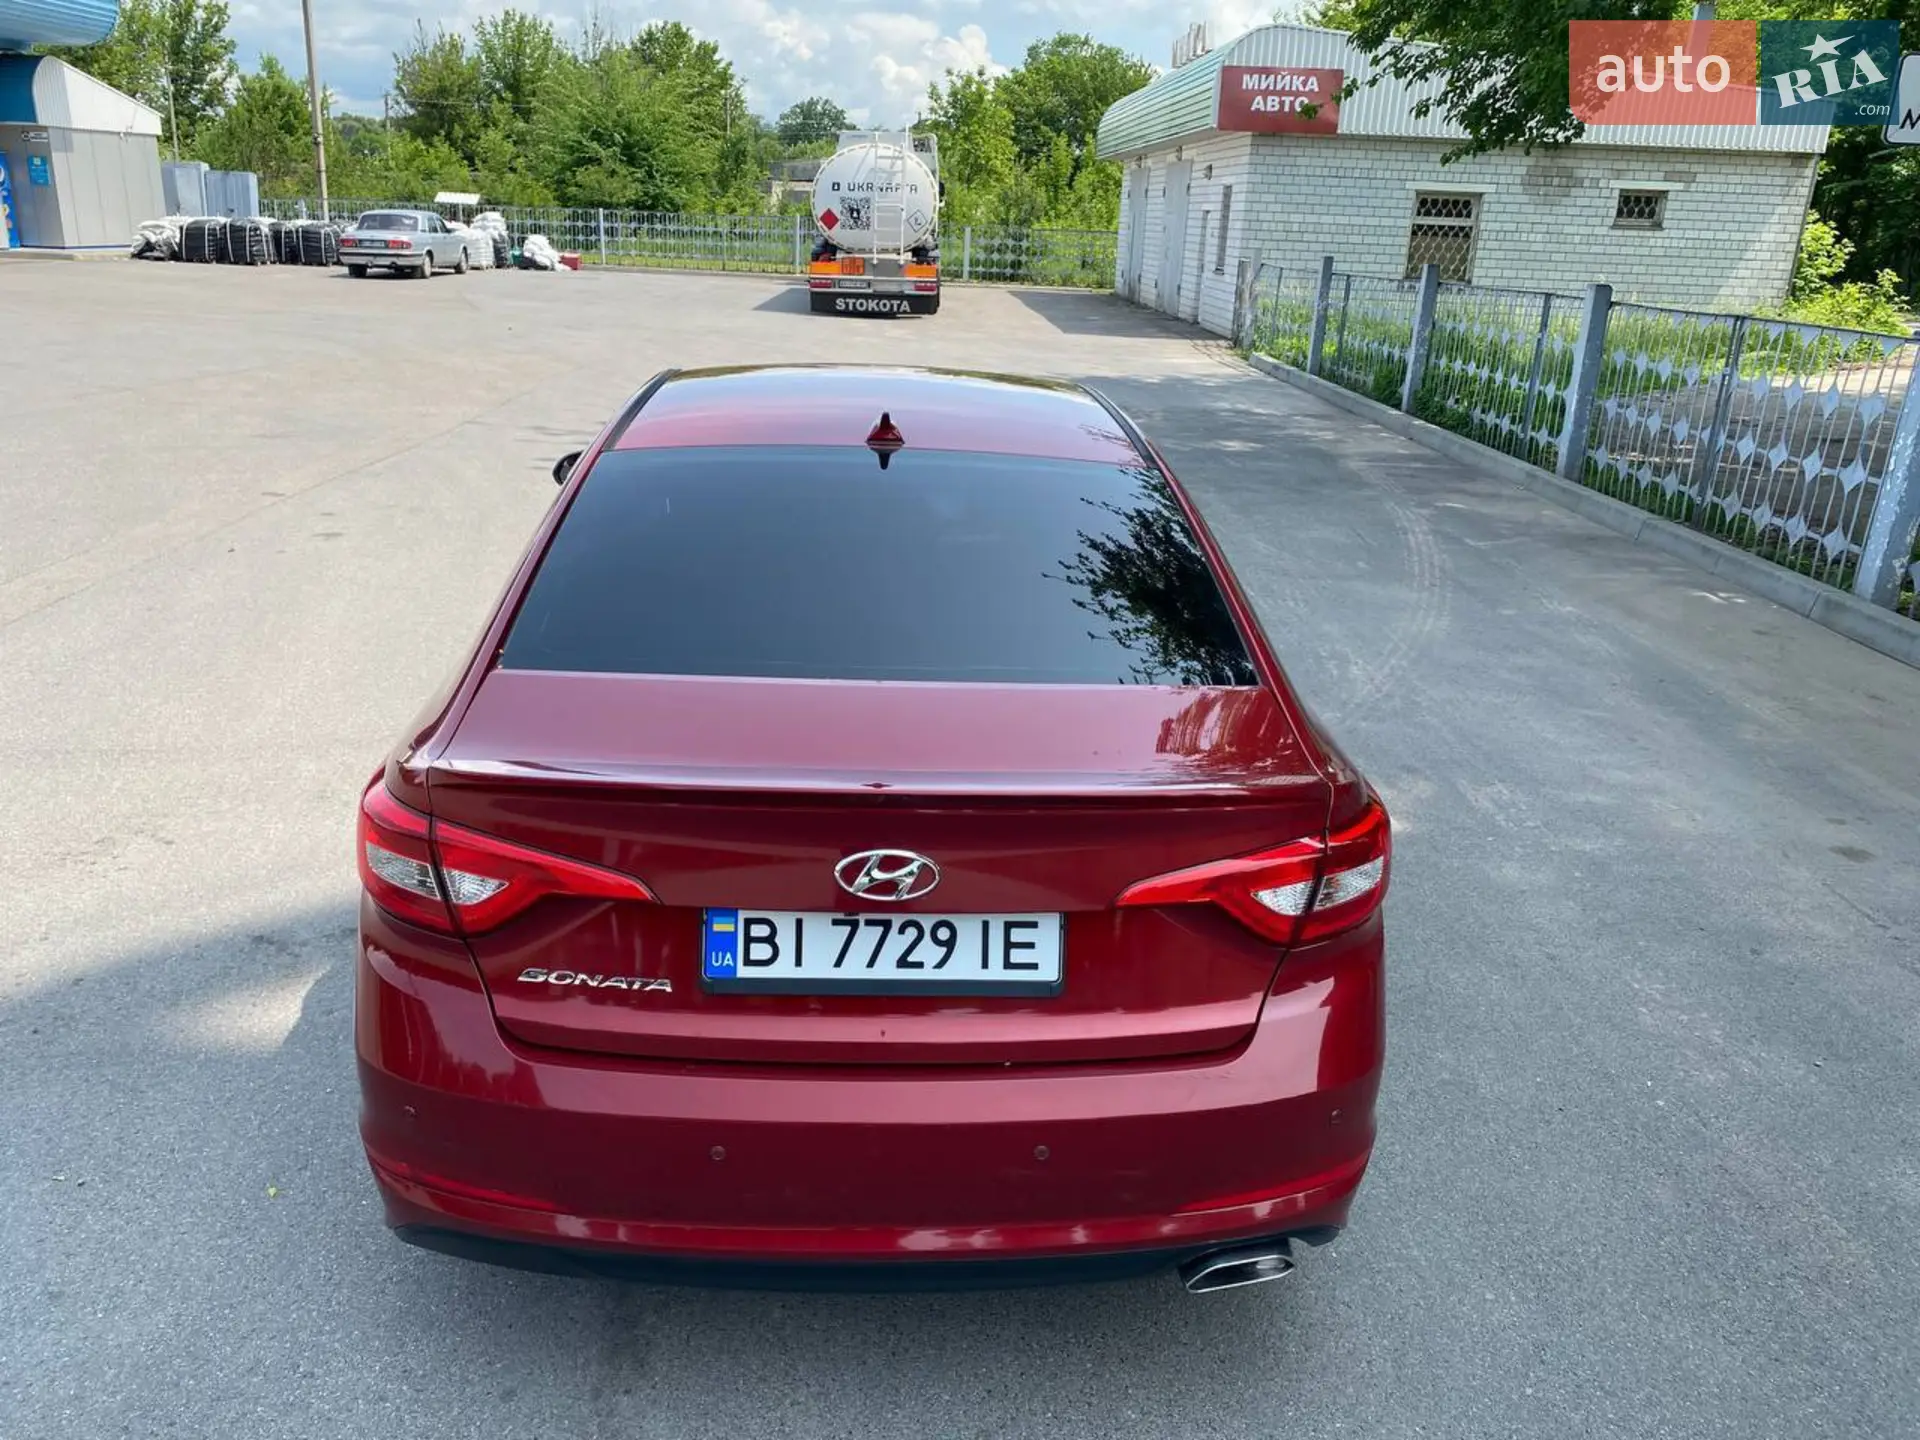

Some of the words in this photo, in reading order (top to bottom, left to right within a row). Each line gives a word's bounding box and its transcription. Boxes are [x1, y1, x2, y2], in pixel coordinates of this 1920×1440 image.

[1242, 71, 1319, 92] МИЙКА
[835, 298, 911, 313] STOKOTA
[743, 917, 803, 968] BI
[831, 918, 957, 969] 7729
[981, 919, 1039, 970] IE
[712, 951, 734, 967] UA
[517, 967, 673, 993] SONATA
